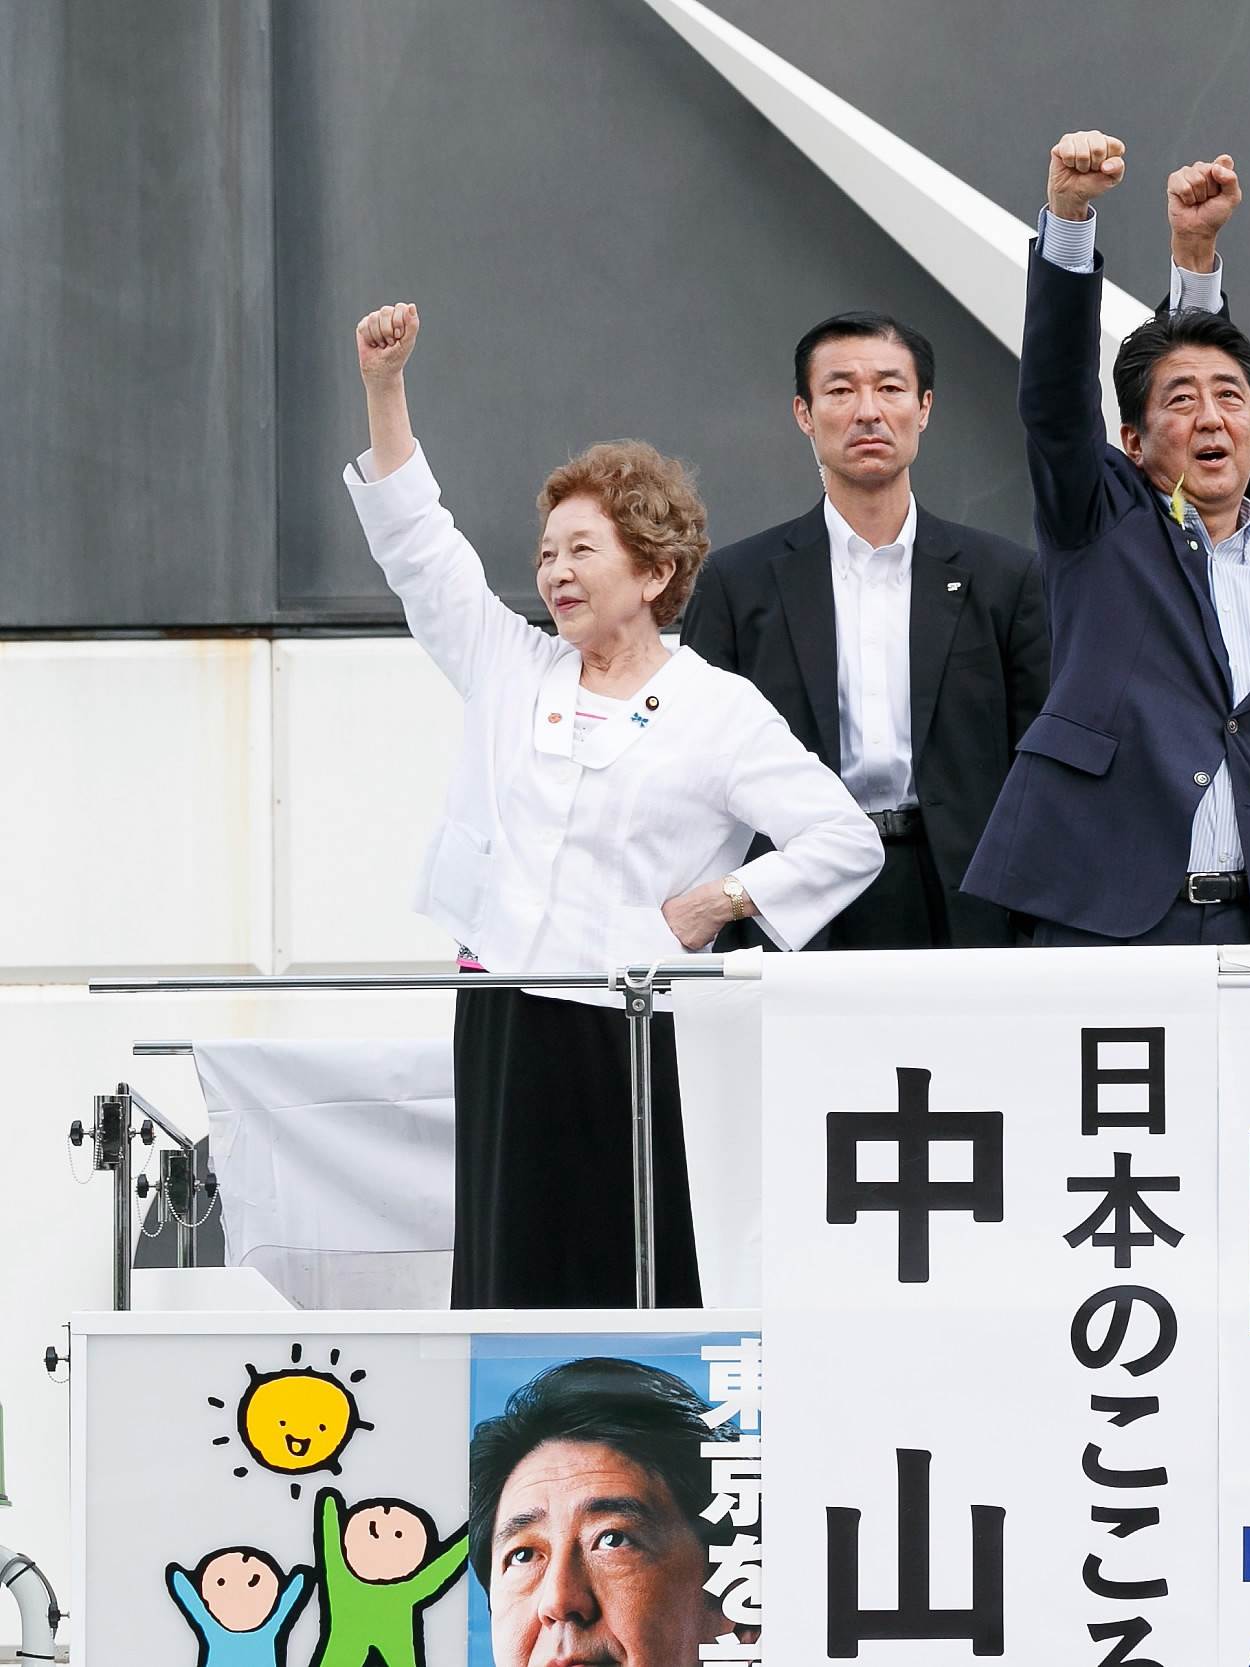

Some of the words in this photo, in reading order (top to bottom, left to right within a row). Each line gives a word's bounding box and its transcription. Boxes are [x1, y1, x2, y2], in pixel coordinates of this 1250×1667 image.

[698, 1337, 762, 1667] 東京を
[826, 1066, 1007, 1659] 中山
